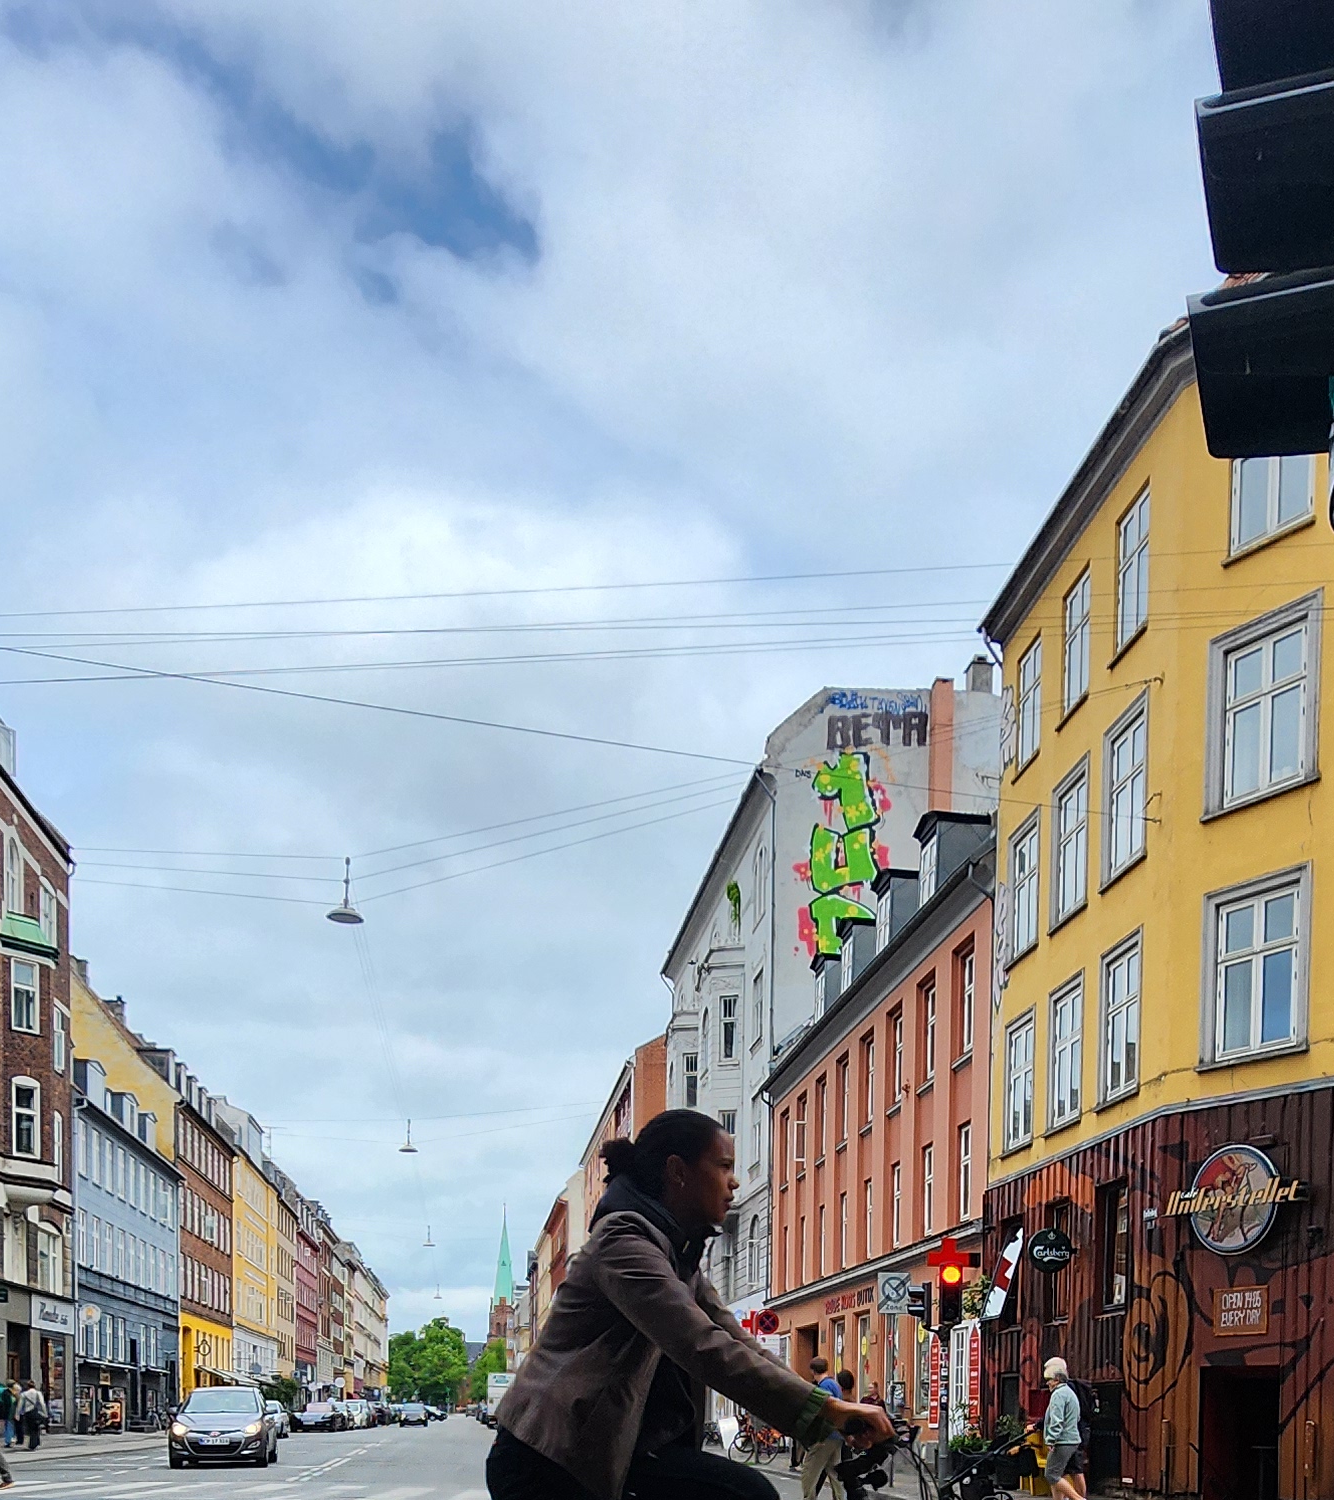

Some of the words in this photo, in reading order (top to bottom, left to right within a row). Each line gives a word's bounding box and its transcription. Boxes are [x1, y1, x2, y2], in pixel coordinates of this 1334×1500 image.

[826, 711, 929, 751] BETA
[1033, 1245, 1070, 1260] Carlsberg
[1222, 1292, 1243, 1310] OPEN
[1221, 1309, 1245, 1327] EVERY
[1246, 1308, 1261, 1325] DAY
